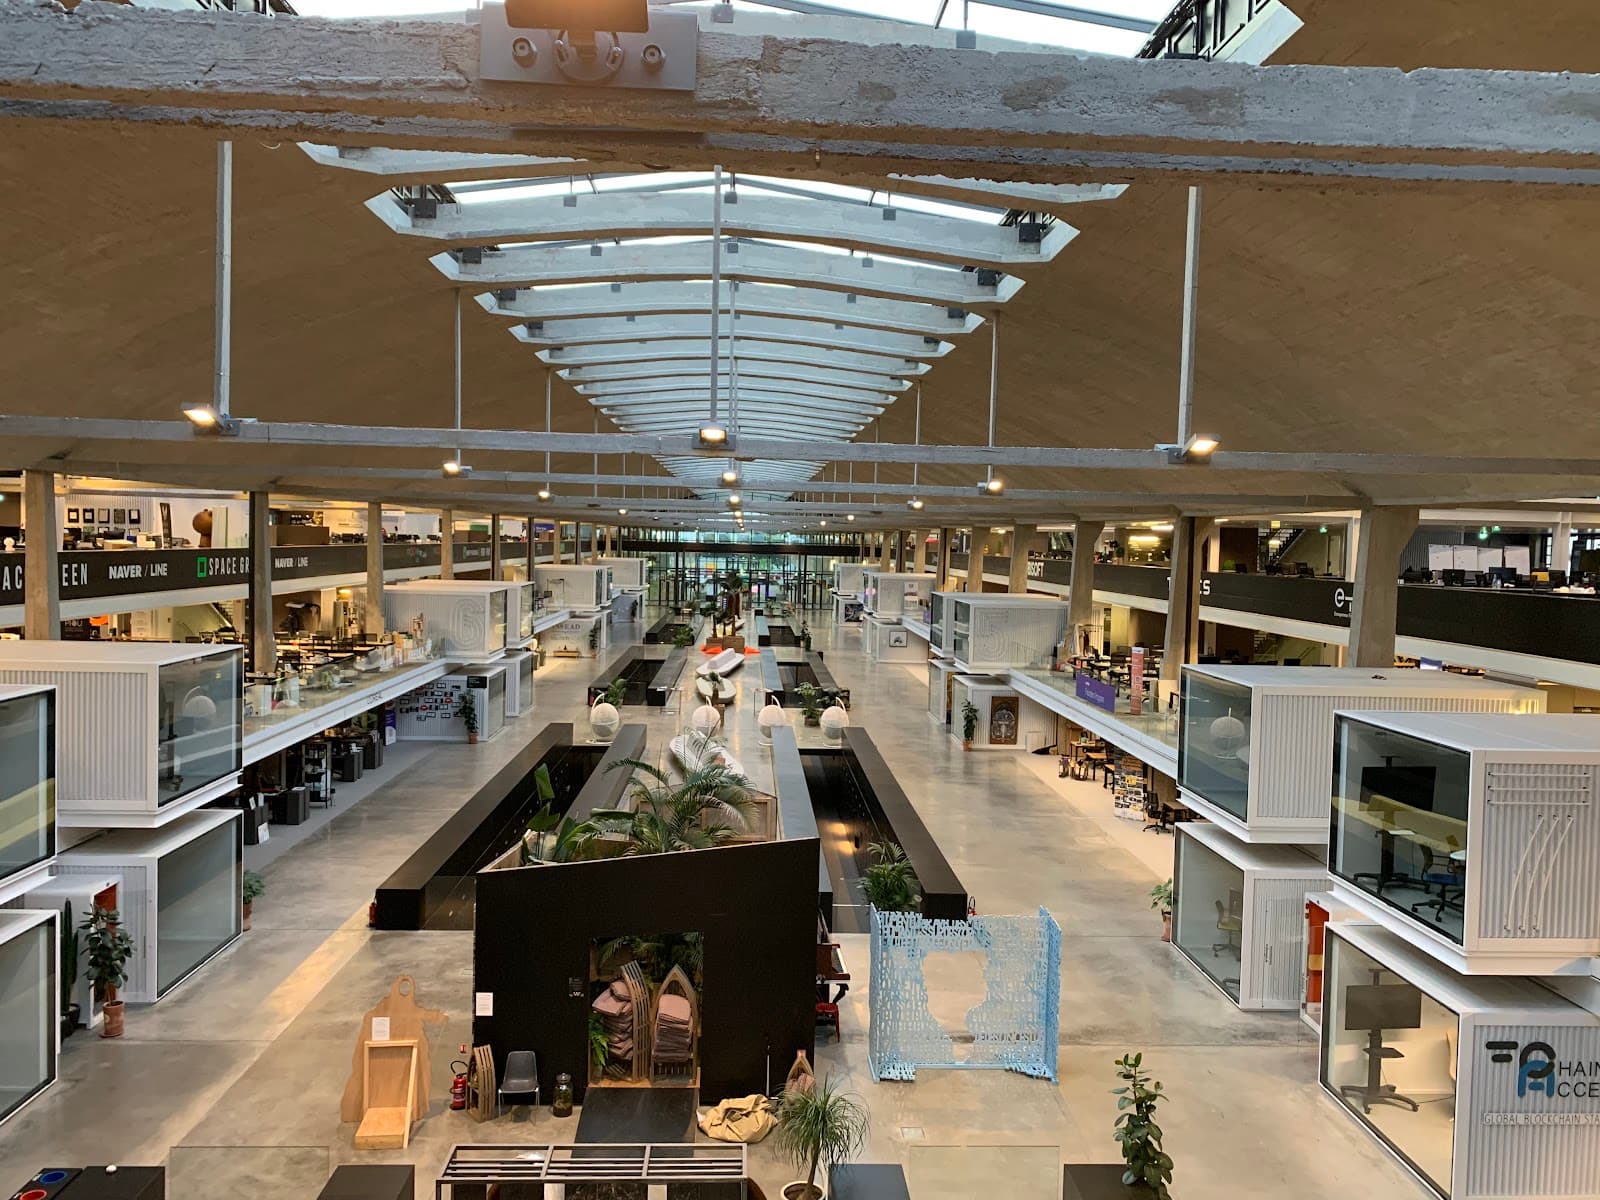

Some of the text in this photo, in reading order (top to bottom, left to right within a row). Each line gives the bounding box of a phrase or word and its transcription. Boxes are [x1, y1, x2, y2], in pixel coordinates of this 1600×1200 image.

[108, 564, 142, 580] NAVER
[150, 562, 168, 577] LINE
[208, 556, 249, 576] SPACE GR
[274, 557, 294, 569] NAVER
[297, 556, 309, 567] LINE
[2, 564, 23, 591] AC
[62, 562, 88, 587] EEN
[1557, 1080, 1600, 1098] CCE
[1484, 1113, 1600, 1125] GLOBAL BLOCKCHAIN STA
